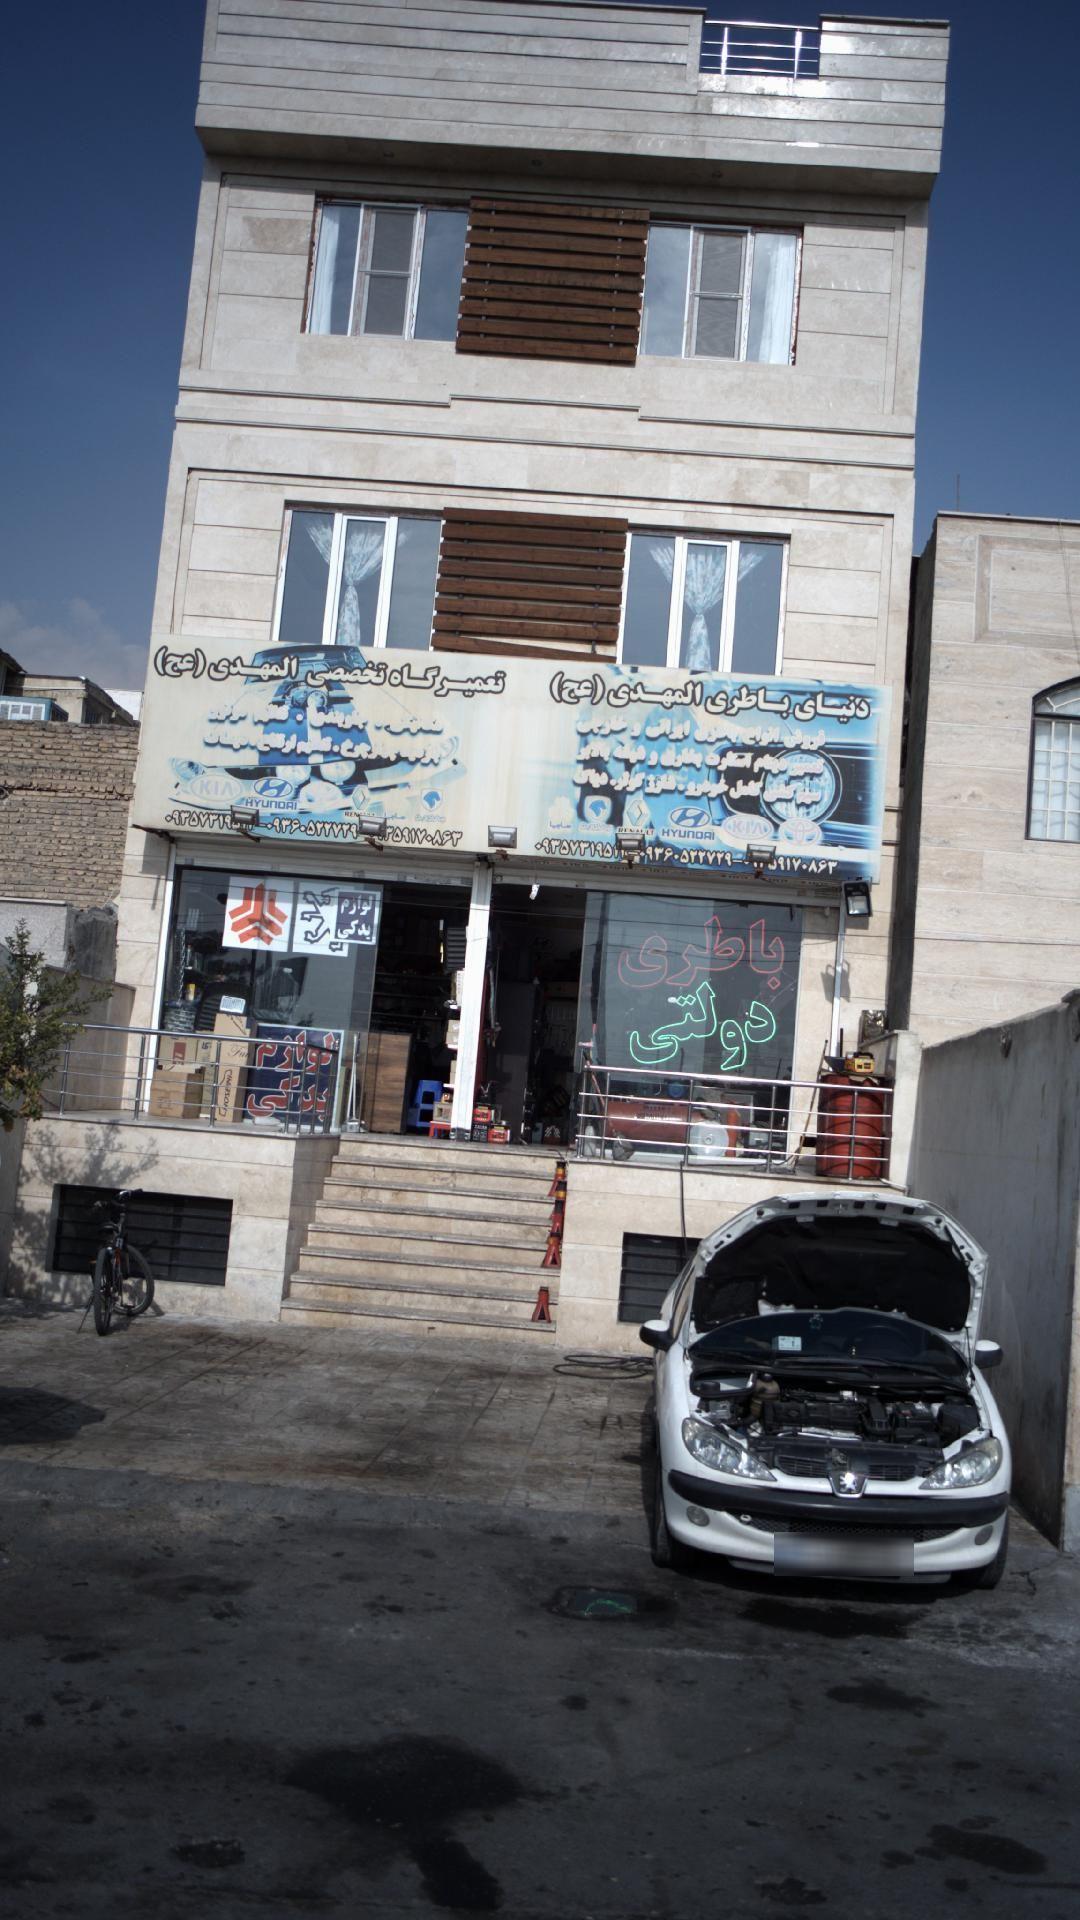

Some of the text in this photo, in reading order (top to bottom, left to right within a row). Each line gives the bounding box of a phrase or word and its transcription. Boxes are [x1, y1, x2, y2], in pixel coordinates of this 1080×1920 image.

[154, 645, 207, 679] (عج)
[208, 655, 299, 681] المهدی
[307, 660, 388, 688] تخصصی
[550, 670, 871, 724] دنیای باطری المهدی (عج)
[741, 725, 781, 746] انواع
[783, 727, 825, 750] فروش
[245, 796, 298, 810] HYUNDAI
[661, 828, 715, 840] HYUNDAI
[340, 895, 373, 915] لوازم
[336, 920, 372, 940] یدکی
[617, 915, 785, 991] باطری
[629, 981, 776, 1071] دولتی
[256, 1031, 333, 1073] لوازم
[246, 1076, 329, 1122] یدکی
